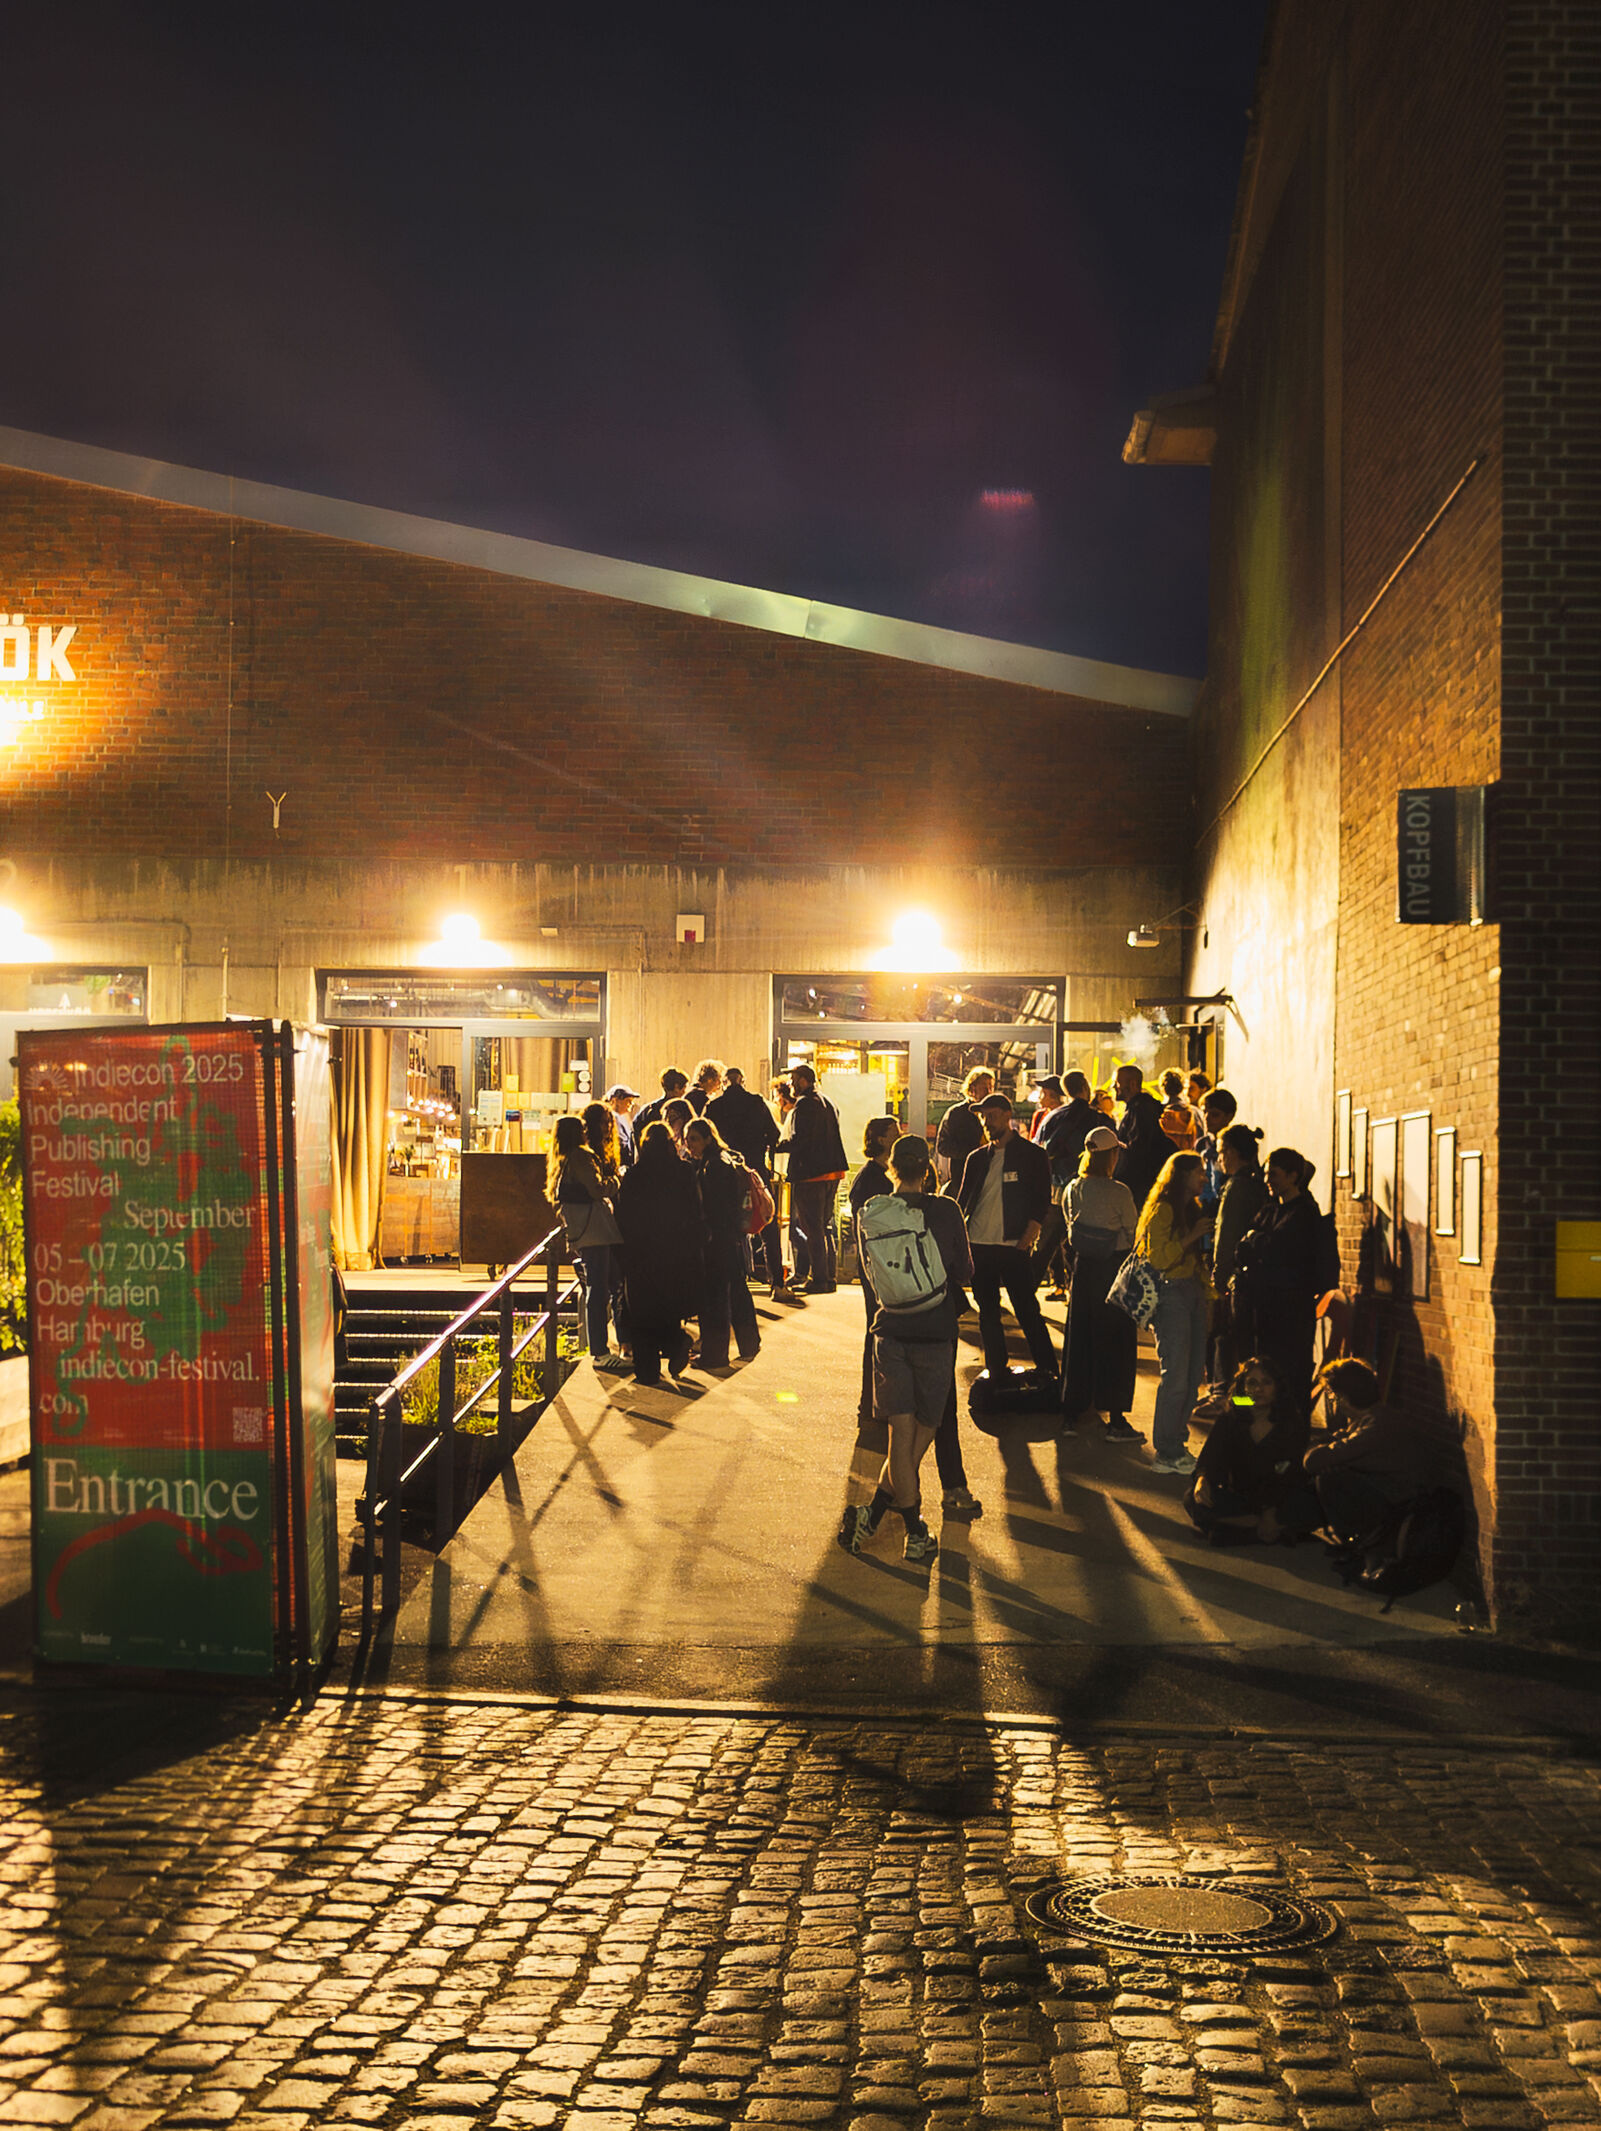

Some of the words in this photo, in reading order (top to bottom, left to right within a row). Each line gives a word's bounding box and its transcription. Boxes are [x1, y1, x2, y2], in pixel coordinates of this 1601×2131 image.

[1406, 795, 1431, 916] KOPFBAU
[73, 1059, 174, 1088] Indiecon
[181, 1054, 244, 1084] 2025
[27, 1095, 178, 1125] Independent
[30, 1132, 150, 1166] Publishing
[32, 1170, 120, 1198] Festival
[124, 1199, 256, 1237] September
[126, 1242, 186, 1271] 2025
[36, 1277, 160, 1306] Oberhafen
[60, 1350, 261, 1382] indiecon-festival.
[43, 1458, 259, 1521] Entrance
